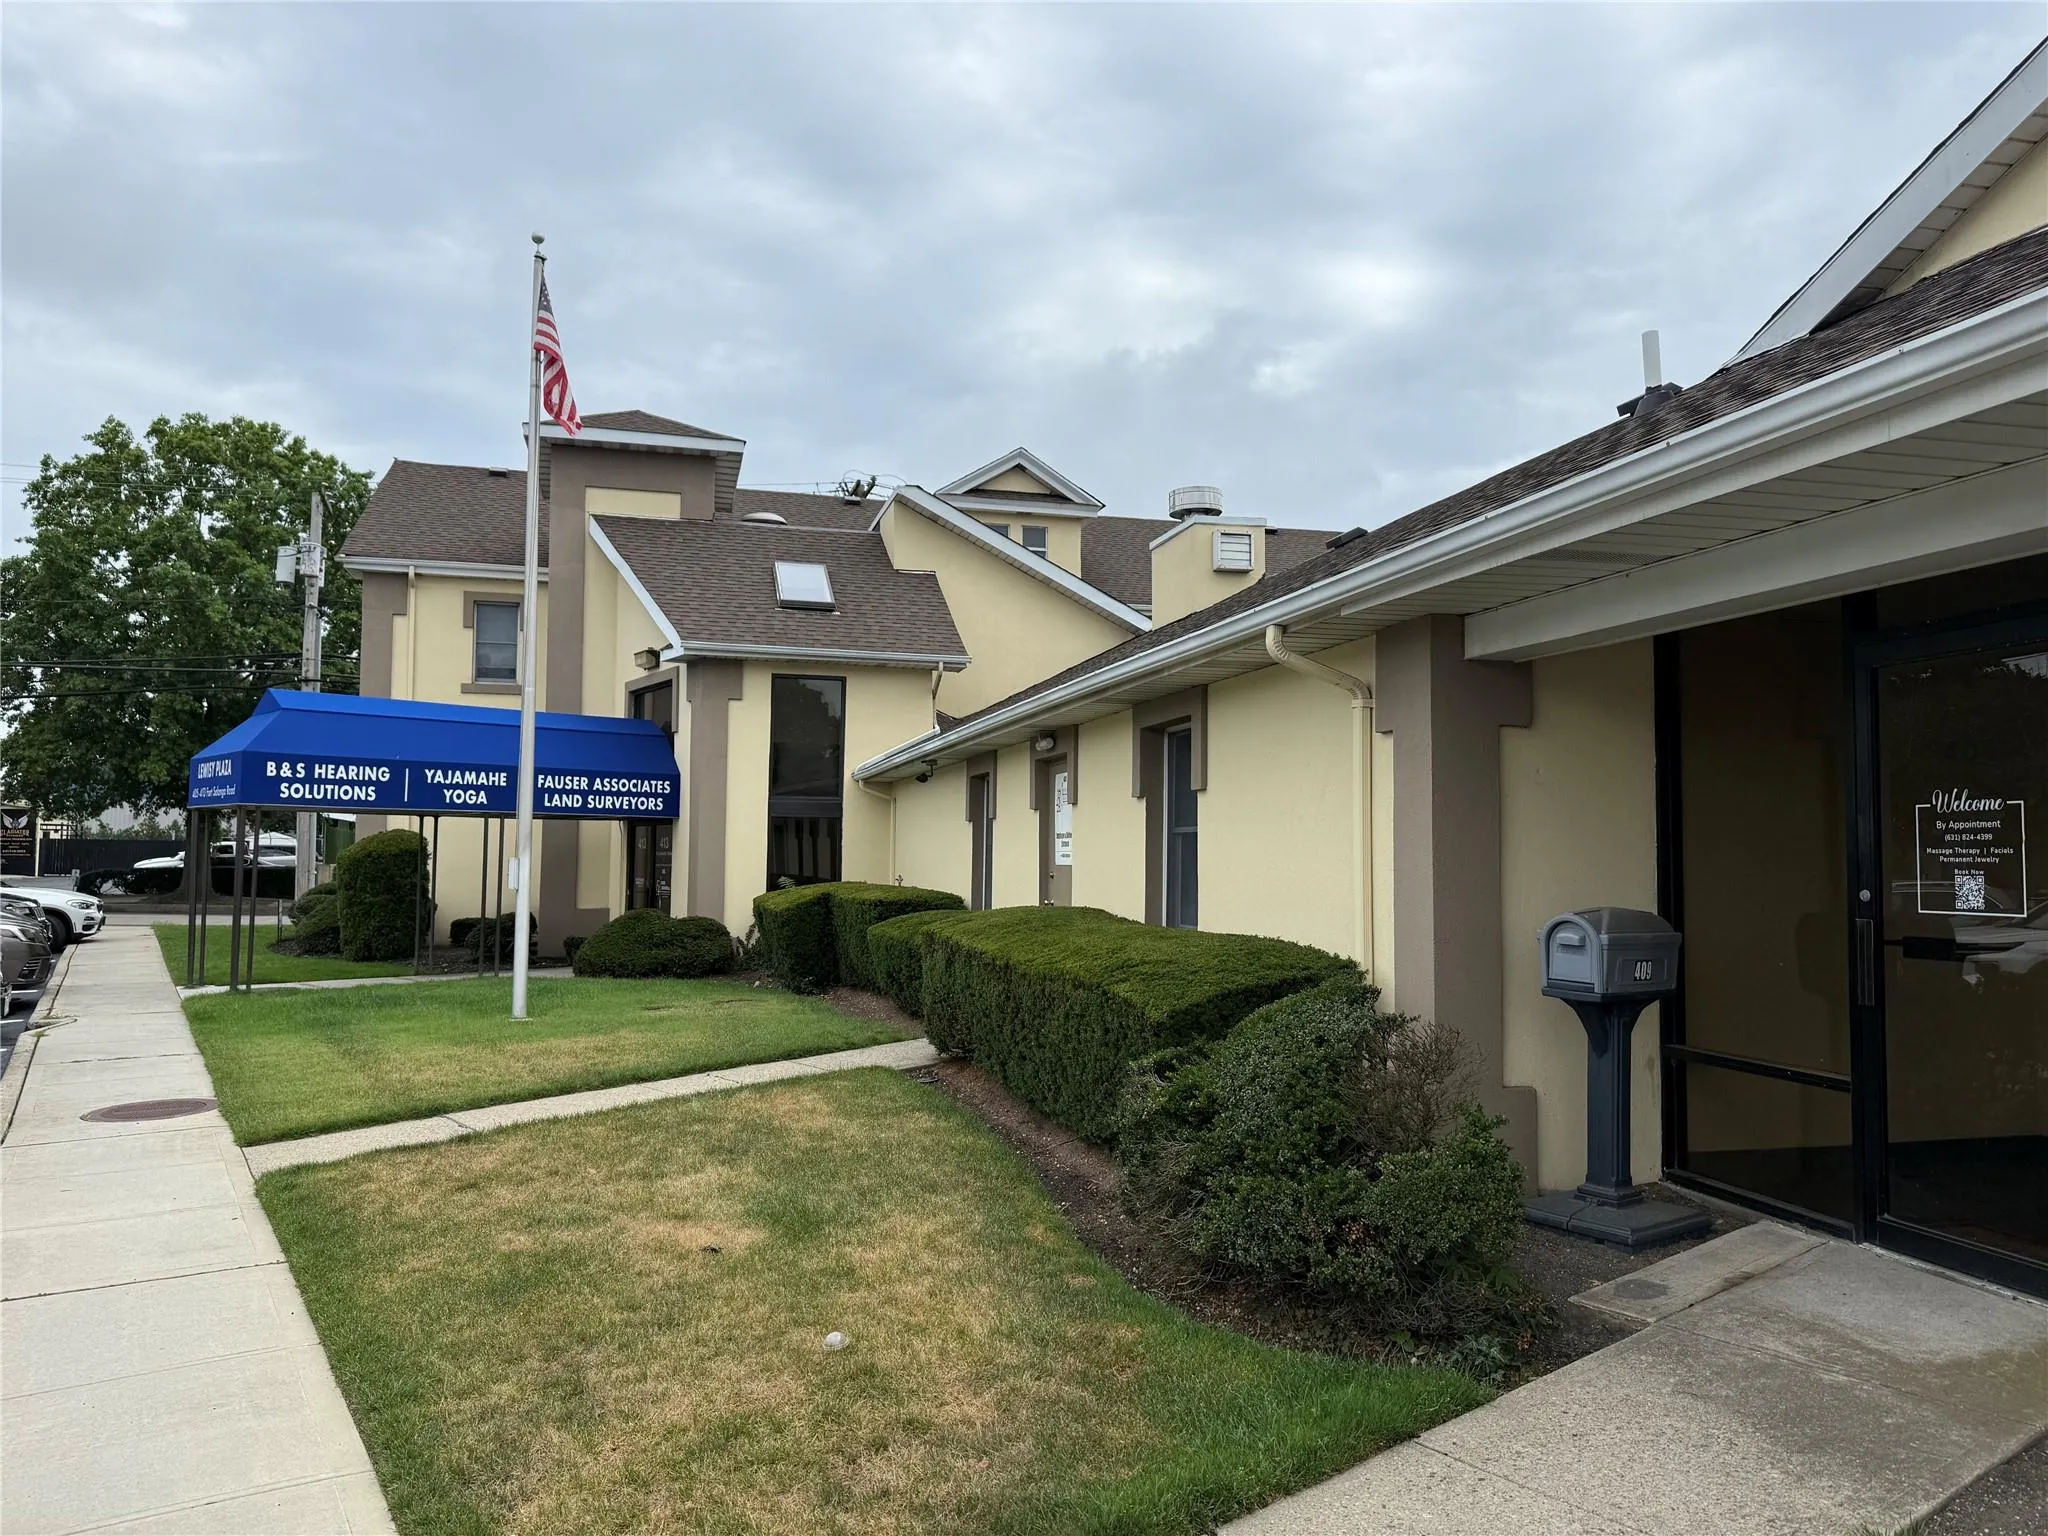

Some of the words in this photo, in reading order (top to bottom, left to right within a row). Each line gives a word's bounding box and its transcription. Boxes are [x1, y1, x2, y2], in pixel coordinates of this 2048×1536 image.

[215, 759, 232, 777] PLAZA
[266, 761, 277, 777] B
[279, 761, 293, 778] &
[295, 762, 306, 779] S
[314, 763, 391, 782] HEARING
[424, 768, 508, 787] YAJAMAHE
[537, 774, 588, 791] FAUSER
[592, 777, 671, 794] ASSOCIATES
[279, 782, 377, 801] SOLUTIONS
[443, 789, 488, 805] YOGA
[544, 793, 583, 808] LAND
[587, 795, 664, 811] SURVEYORS
[1932, 788, 2005, 814] Welcome
[1936, 820, 1947, 830] By
[1948, 819, 2001, 830] Appointment
[1944, 834, 1961, 842] (631)
[1961, 833, 1993, 841] 824-4399
[1926, 847, 1953, 856] Massage
[1955, 846, 1980, 856] Therapy
[1990, 847, 2014, 855] Facials
[1939, 855, 1973, 863] Permanent
[1974, 856, 2000, 864] Jewelry
[1634, 961, 1652, 980] 409
